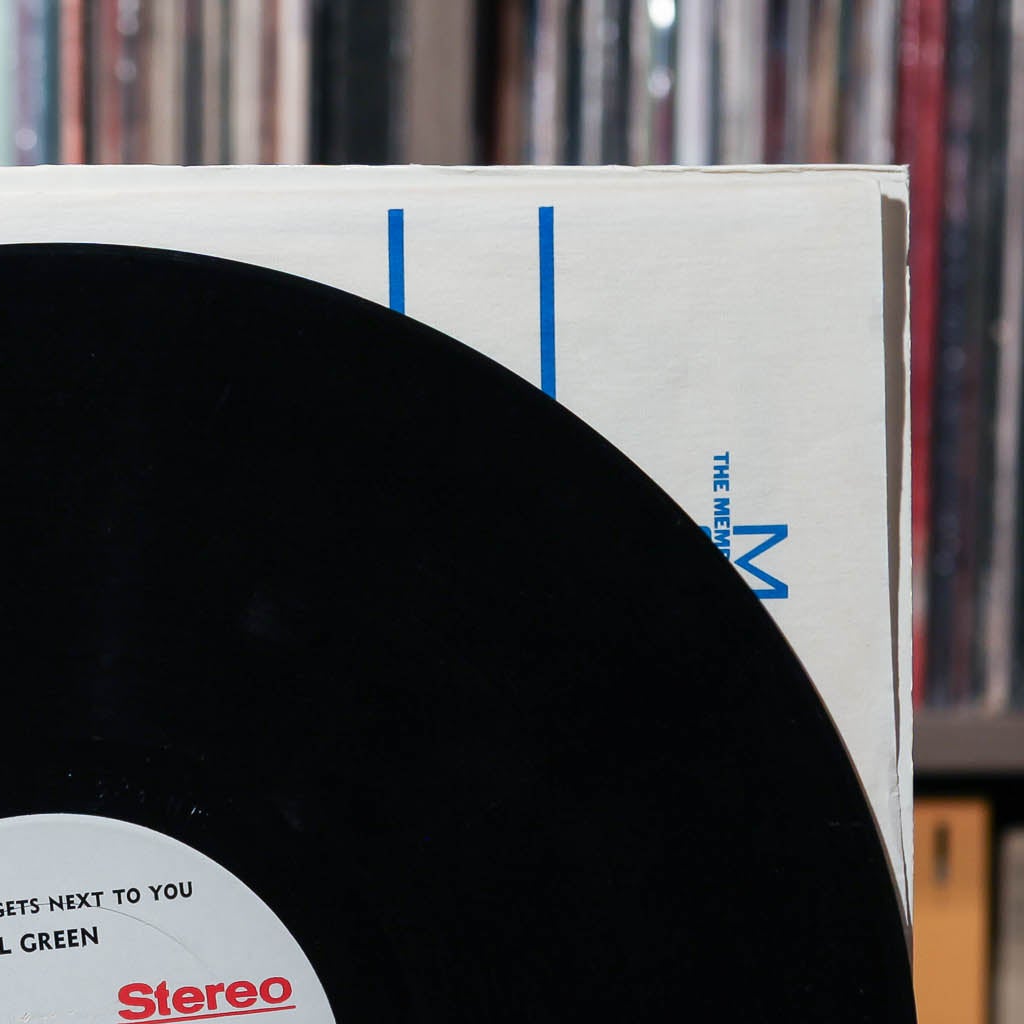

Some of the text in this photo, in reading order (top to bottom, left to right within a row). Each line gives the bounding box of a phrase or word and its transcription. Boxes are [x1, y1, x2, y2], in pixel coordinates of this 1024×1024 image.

[713, 451, 730, 492] THE
[49, 891, 104, 912] NEXT
[112, 887, 141, 905] TO
[148, 881, 193, 901] YOU
[20, 926, 99, 953] GREEN
[117, 976, 293, 1021] Stereo
